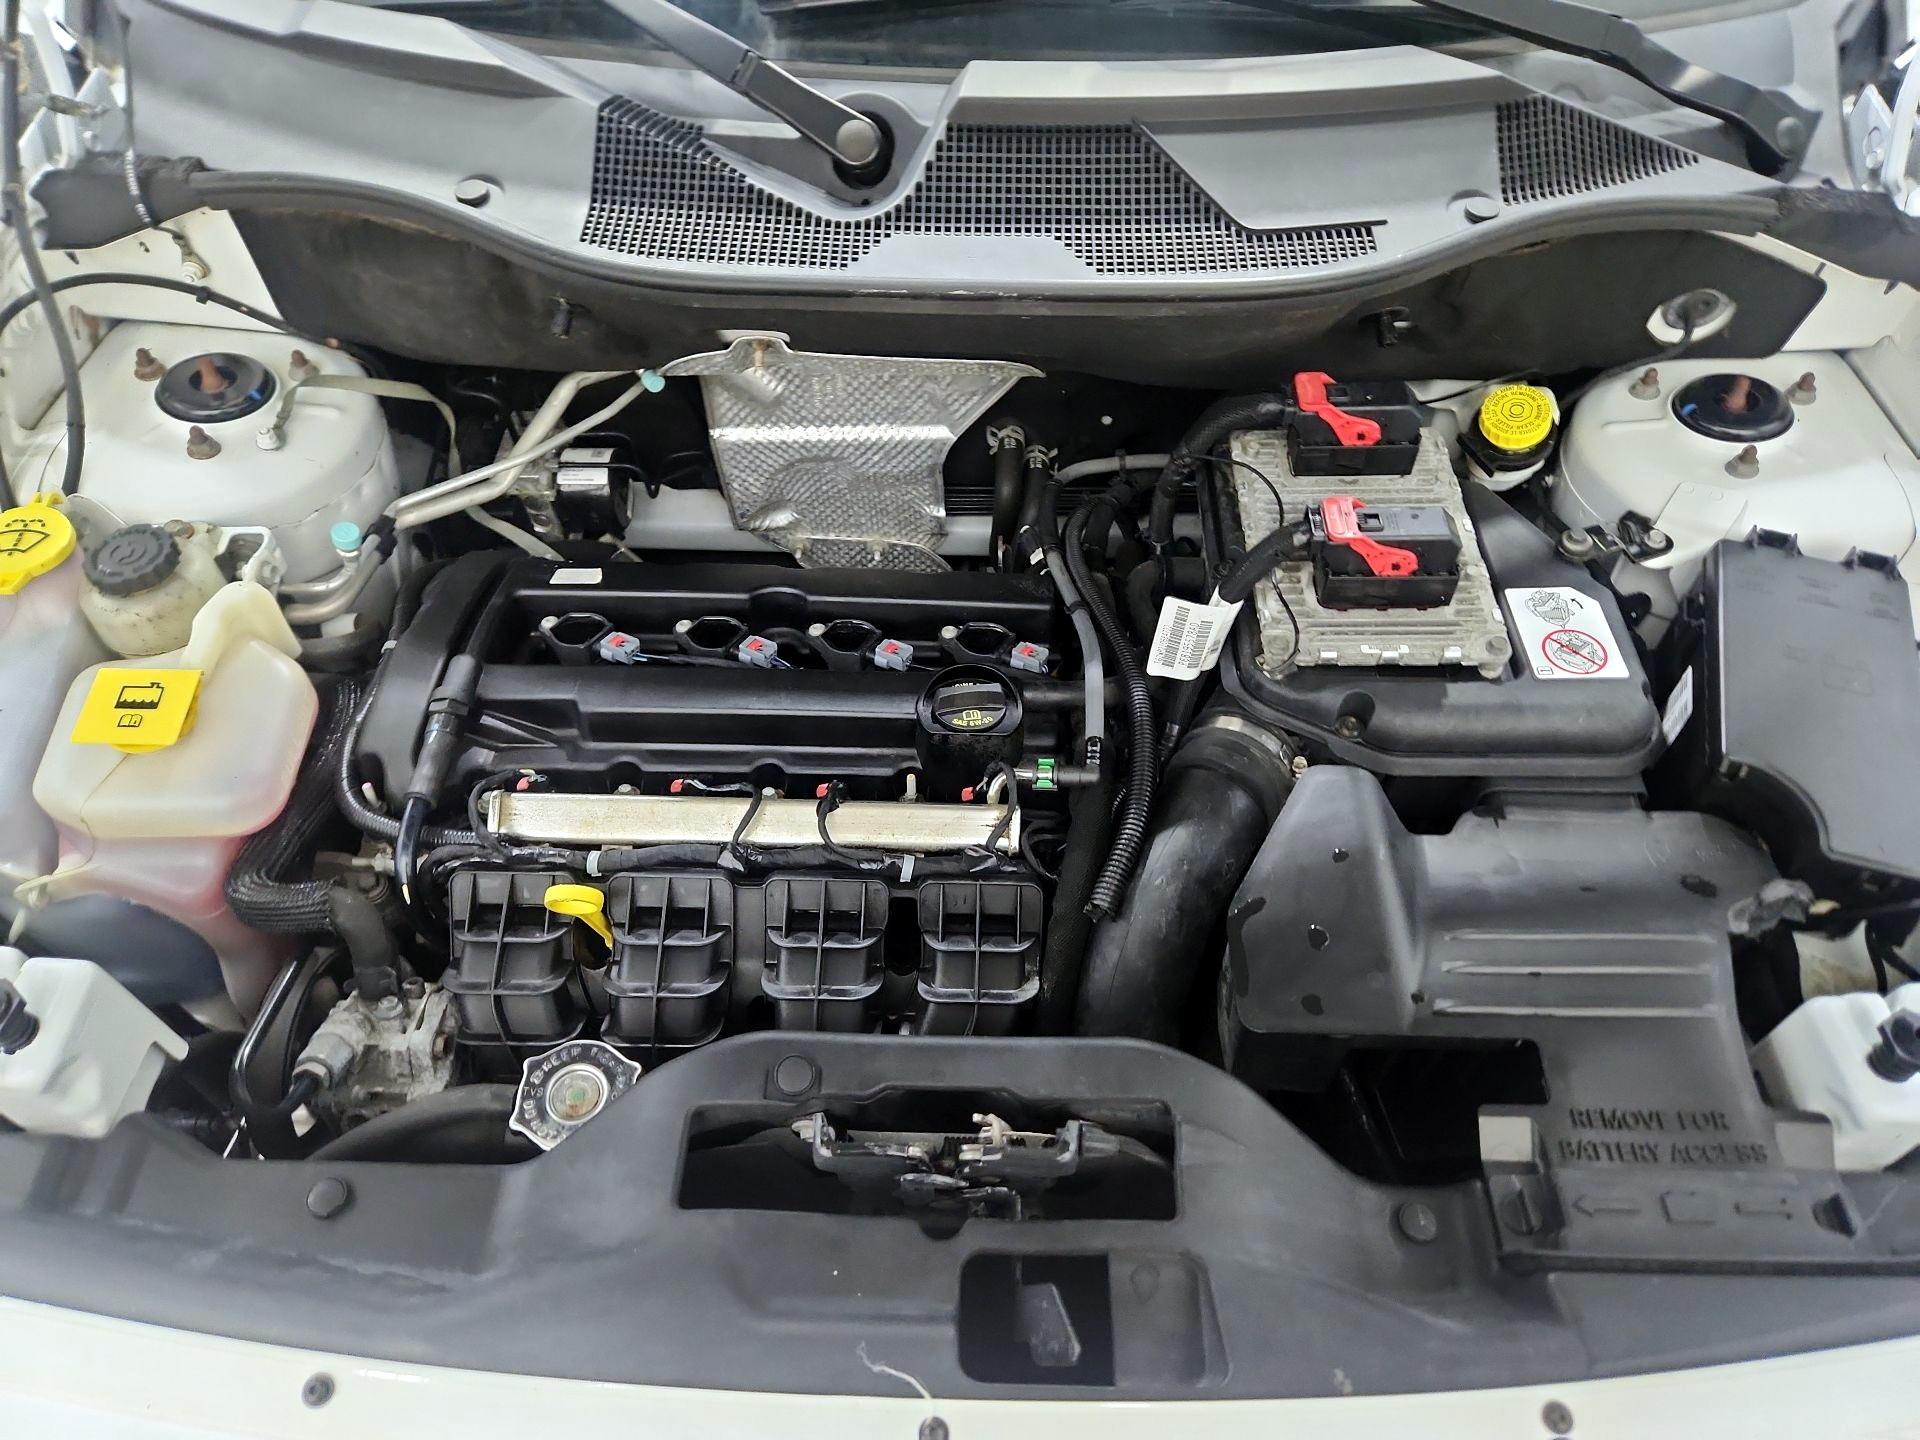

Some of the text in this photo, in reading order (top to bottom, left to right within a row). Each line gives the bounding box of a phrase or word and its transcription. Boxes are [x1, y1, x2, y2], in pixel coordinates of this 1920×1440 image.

[952, 718, 968, 727] SAE
[523, 1086, 544, 1097] TVS
[1568, 1107, 1731, 1132] REMOVE FOR
[1557, 1138, 1768, 1164] BATTERY ACCESS
